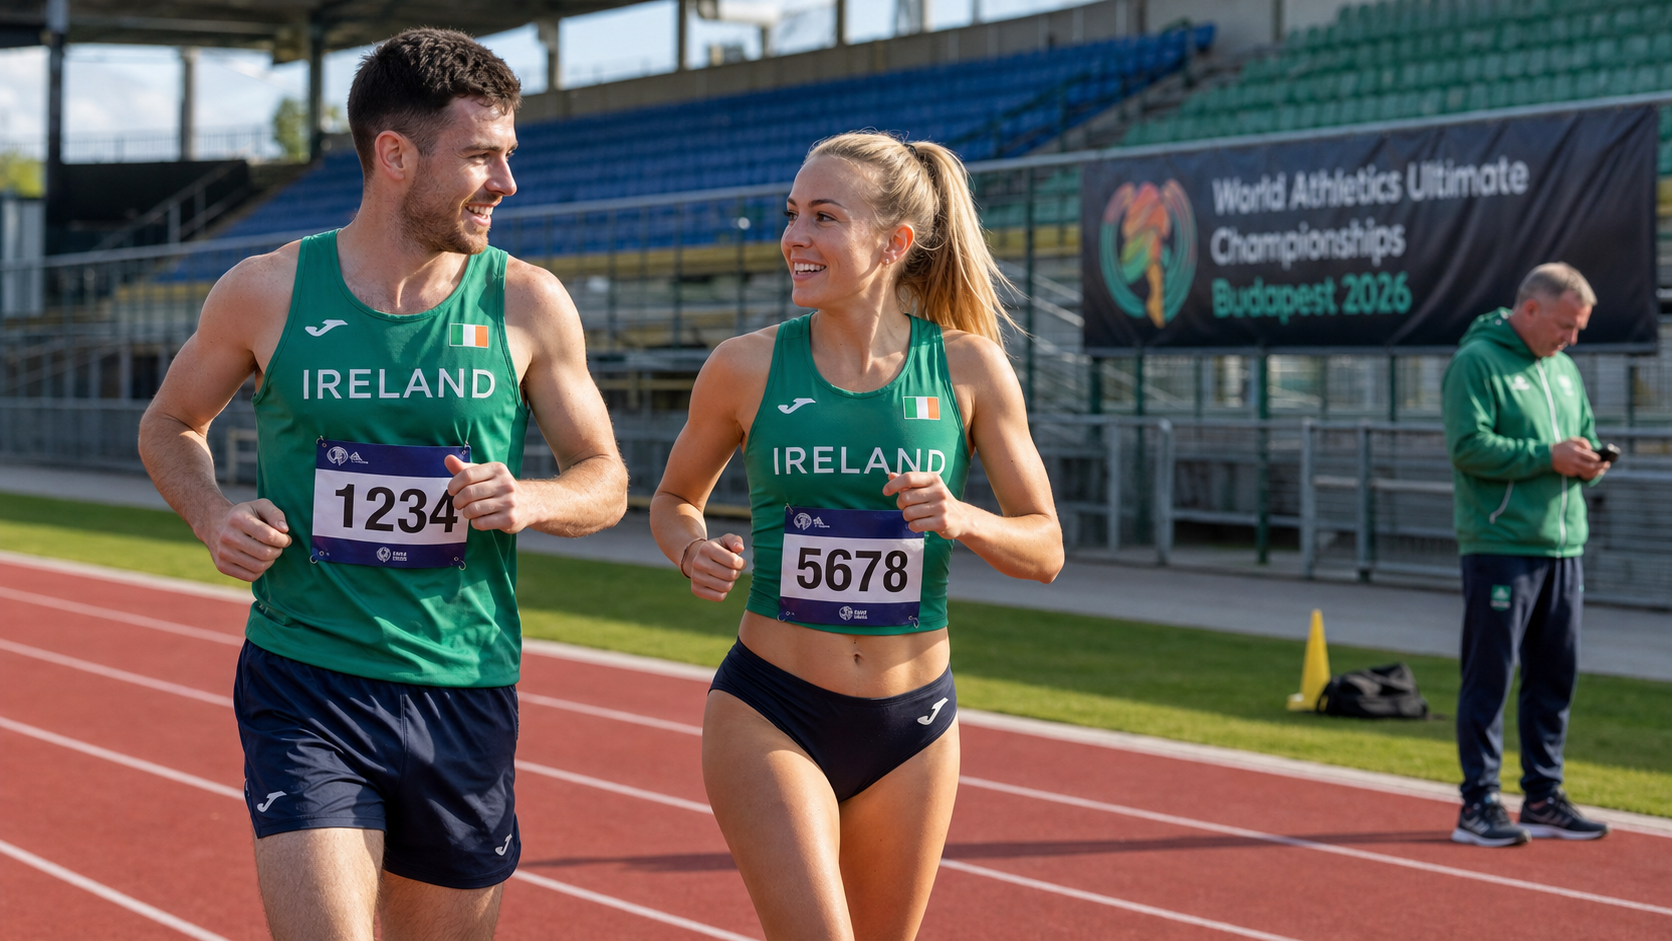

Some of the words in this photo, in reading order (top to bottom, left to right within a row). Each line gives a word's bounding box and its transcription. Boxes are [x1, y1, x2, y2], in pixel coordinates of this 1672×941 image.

[1213, 173, 1286, 215] World
[1290, 163, 1402, 209] Athletics
[1407, 156, 1529, 202] Ultimate
[1210, 218, 1406, 268] Championships
[1212, 276, 1339, 324] Budapest
[1341, 271, 1412, 316] 2026
[303, 368, 496, 400] IRELAND
[773, 446, 946, 476] IRELAND
[335, 483, 458, 534] 1234
[796, 547, 908, 593] 5678
